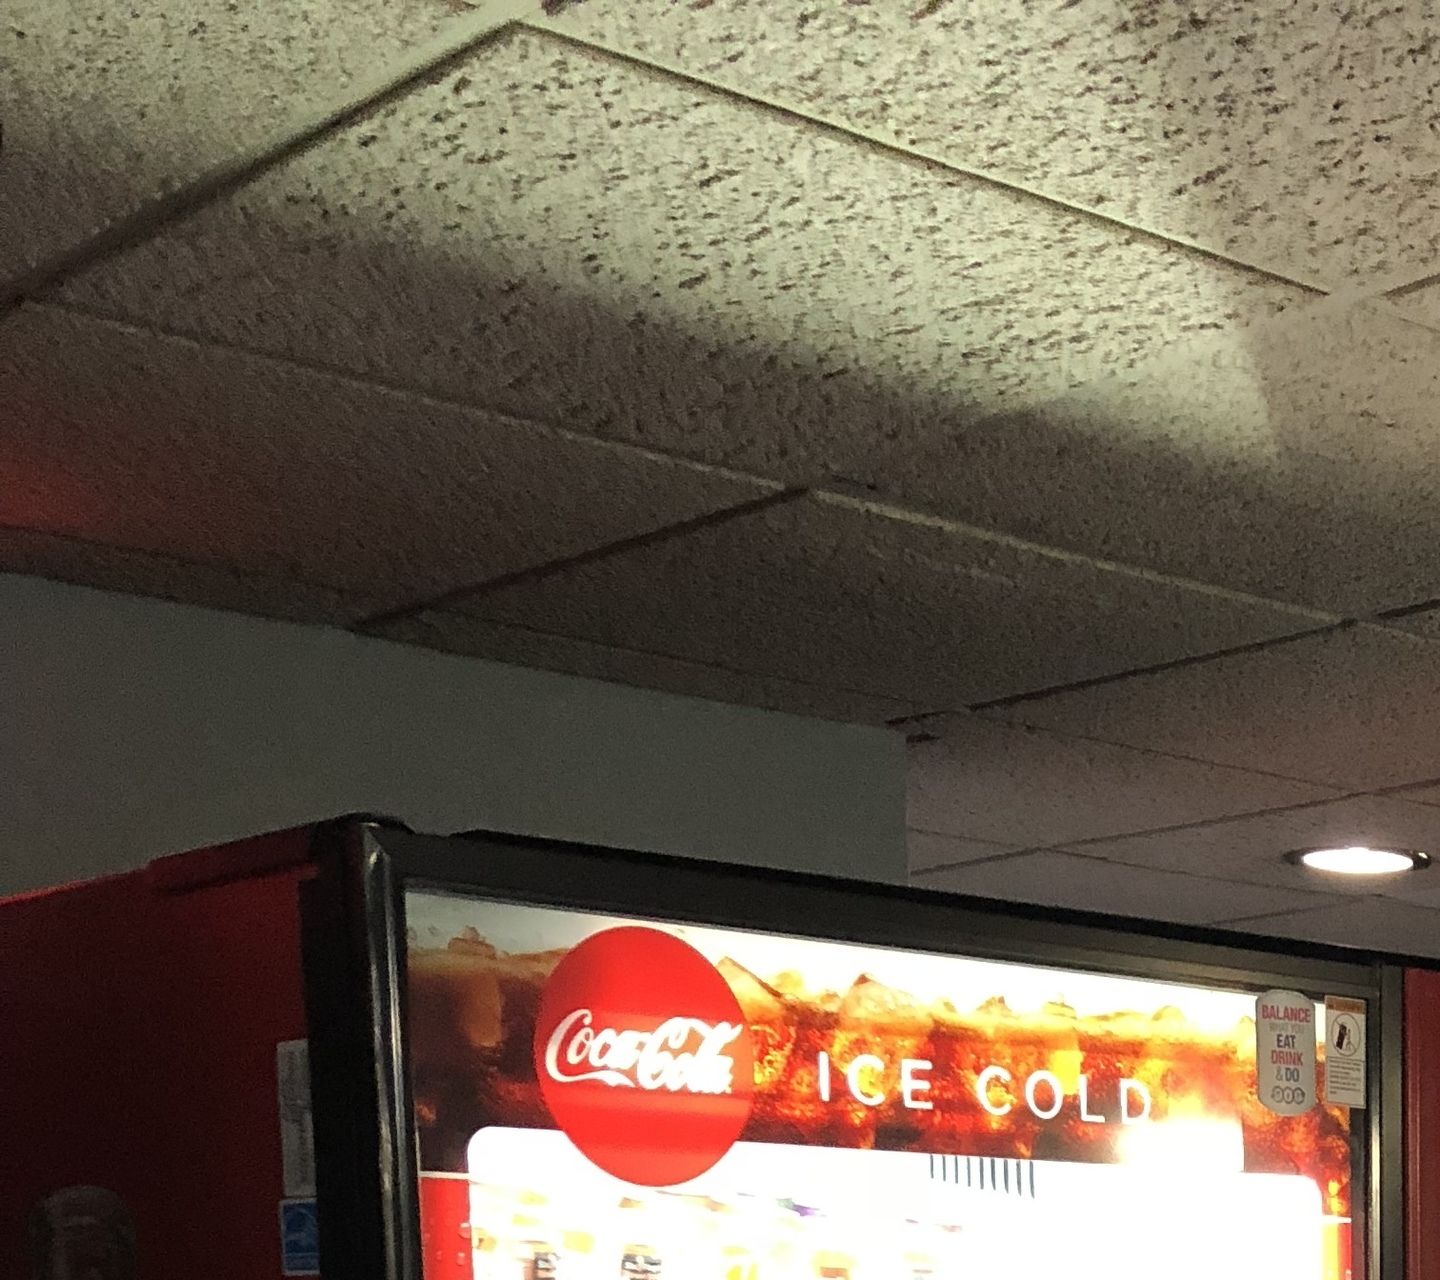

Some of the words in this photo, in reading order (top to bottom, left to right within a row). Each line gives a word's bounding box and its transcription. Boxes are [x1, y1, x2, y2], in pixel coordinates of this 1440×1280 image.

[1261, 1004, 1311, 1023] BALANCE
[1276, 1034, 1296, 1048] EAT
[544, 1007, 744, 1094] Coca-Cola
[1270, 1050, 1304, 1066] DRINK
[1285, 1067, 1300, 1083] DO
[817, 1050, 934, 1110] ICE
[976, 1064, 1152, 1125] COLD
